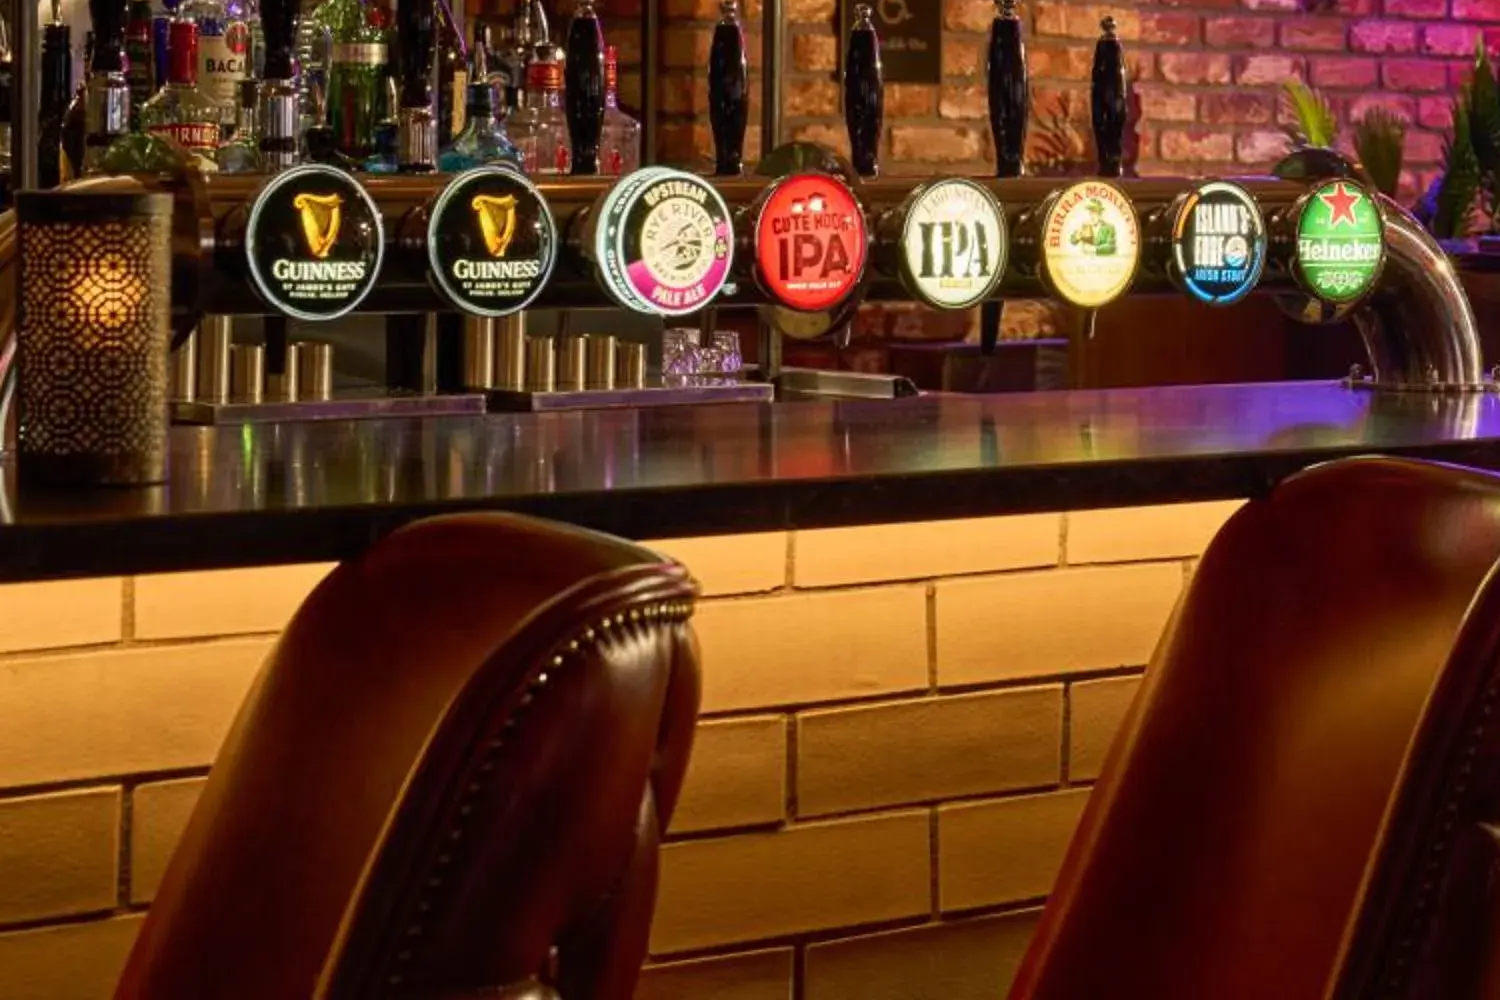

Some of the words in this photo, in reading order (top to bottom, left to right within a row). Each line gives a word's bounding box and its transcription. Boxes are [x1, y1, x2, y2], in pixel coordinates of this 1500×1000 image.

[643, 181, 708, 206] UPSTREAM
[646, 210, 669, 241] RYE
[671, 203, 713, 238] RIVER
[771, 216, 811, 235] CUTE
[778, 233, 852, 281] IPA
[272, 259, 366, 280] GUINNESS
[453, 259, 541, 279] GUINNESS
